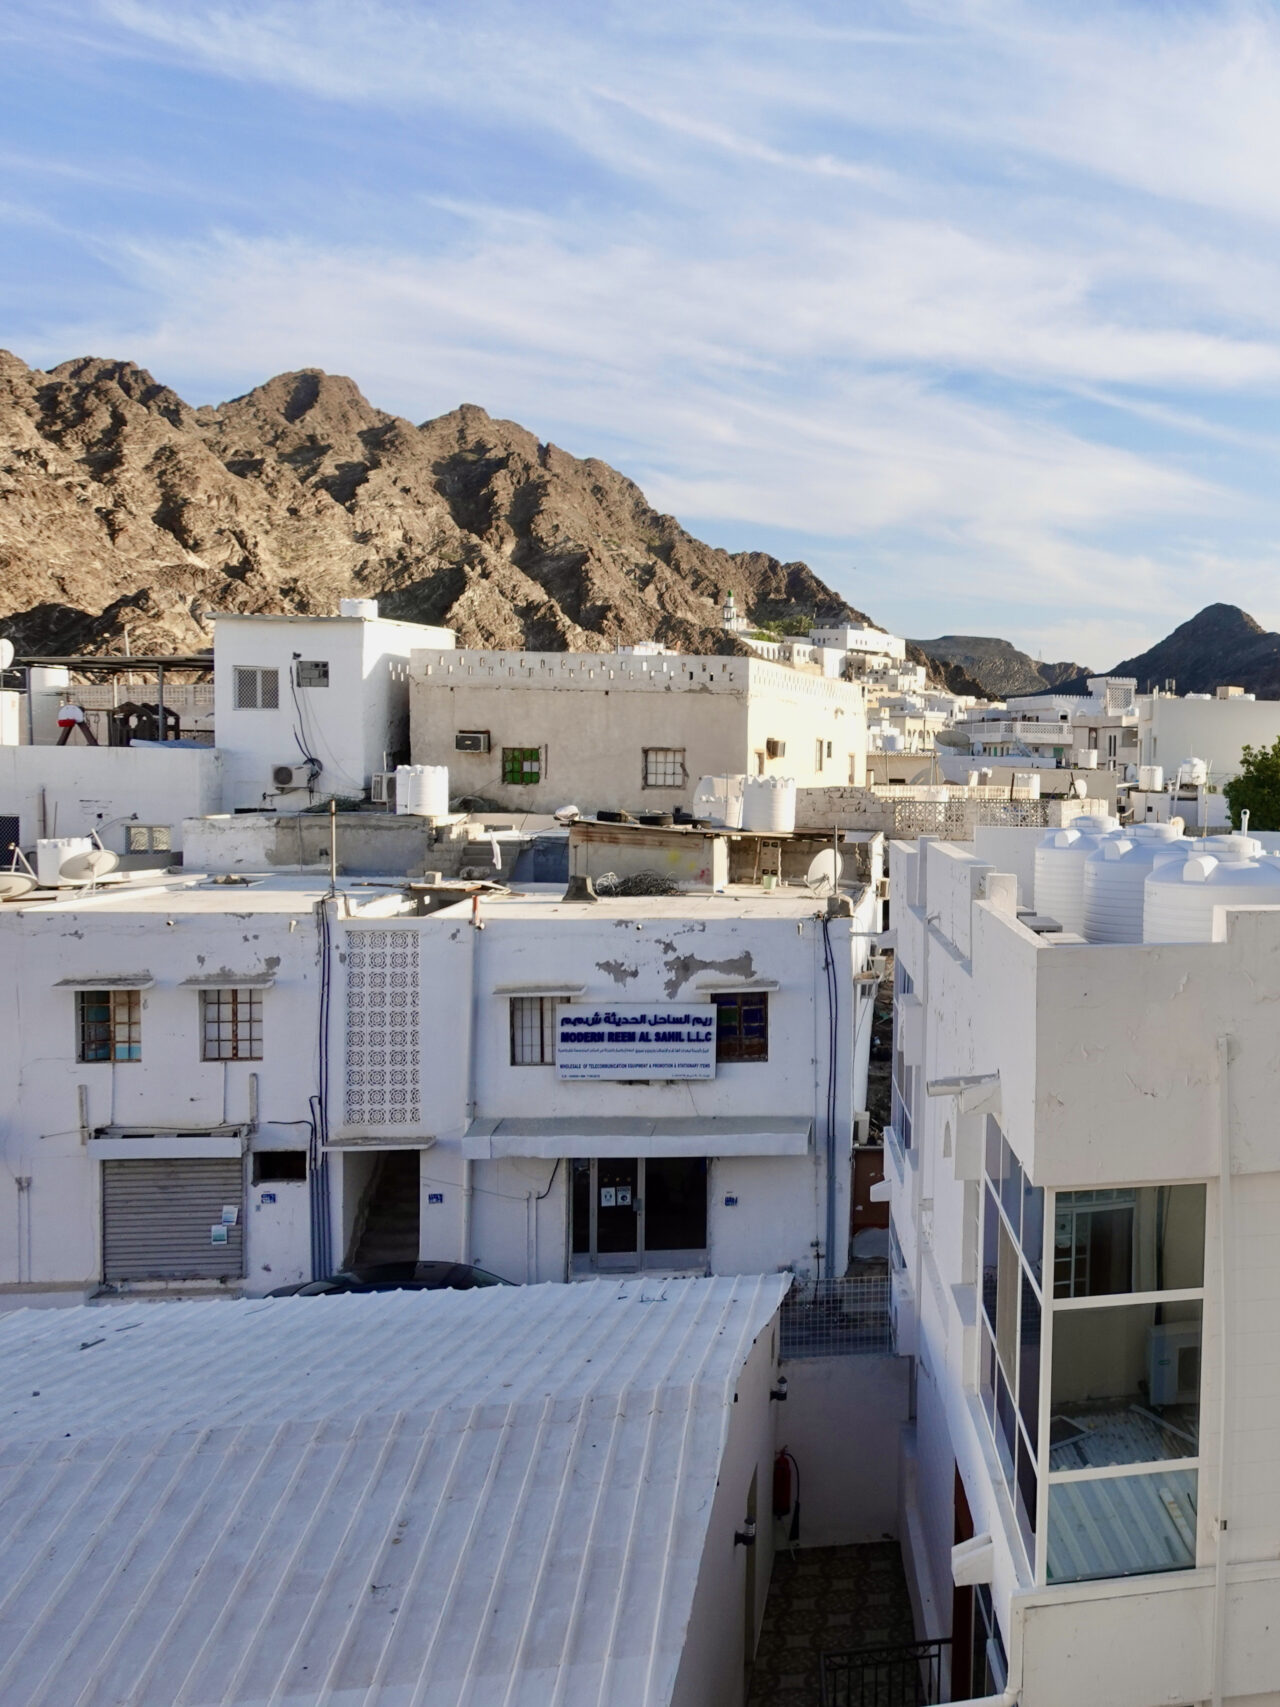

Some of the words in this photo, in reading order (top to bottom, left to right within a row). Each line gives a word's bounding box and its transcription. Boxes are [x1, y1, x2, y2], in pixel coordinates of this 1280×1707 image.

[604, 1012, 646, 1026] الحديثة
[648, 1014, 690, 1026] الساحل
[692, 1016, 712, 1026] ريم
[560, 1031, 605, 1043] MODERN
[607, 1031, 636, 1043] REEM
[638, 1031, 652, 1042] AL
[654, 1031, 684, 1042] SAHIL
